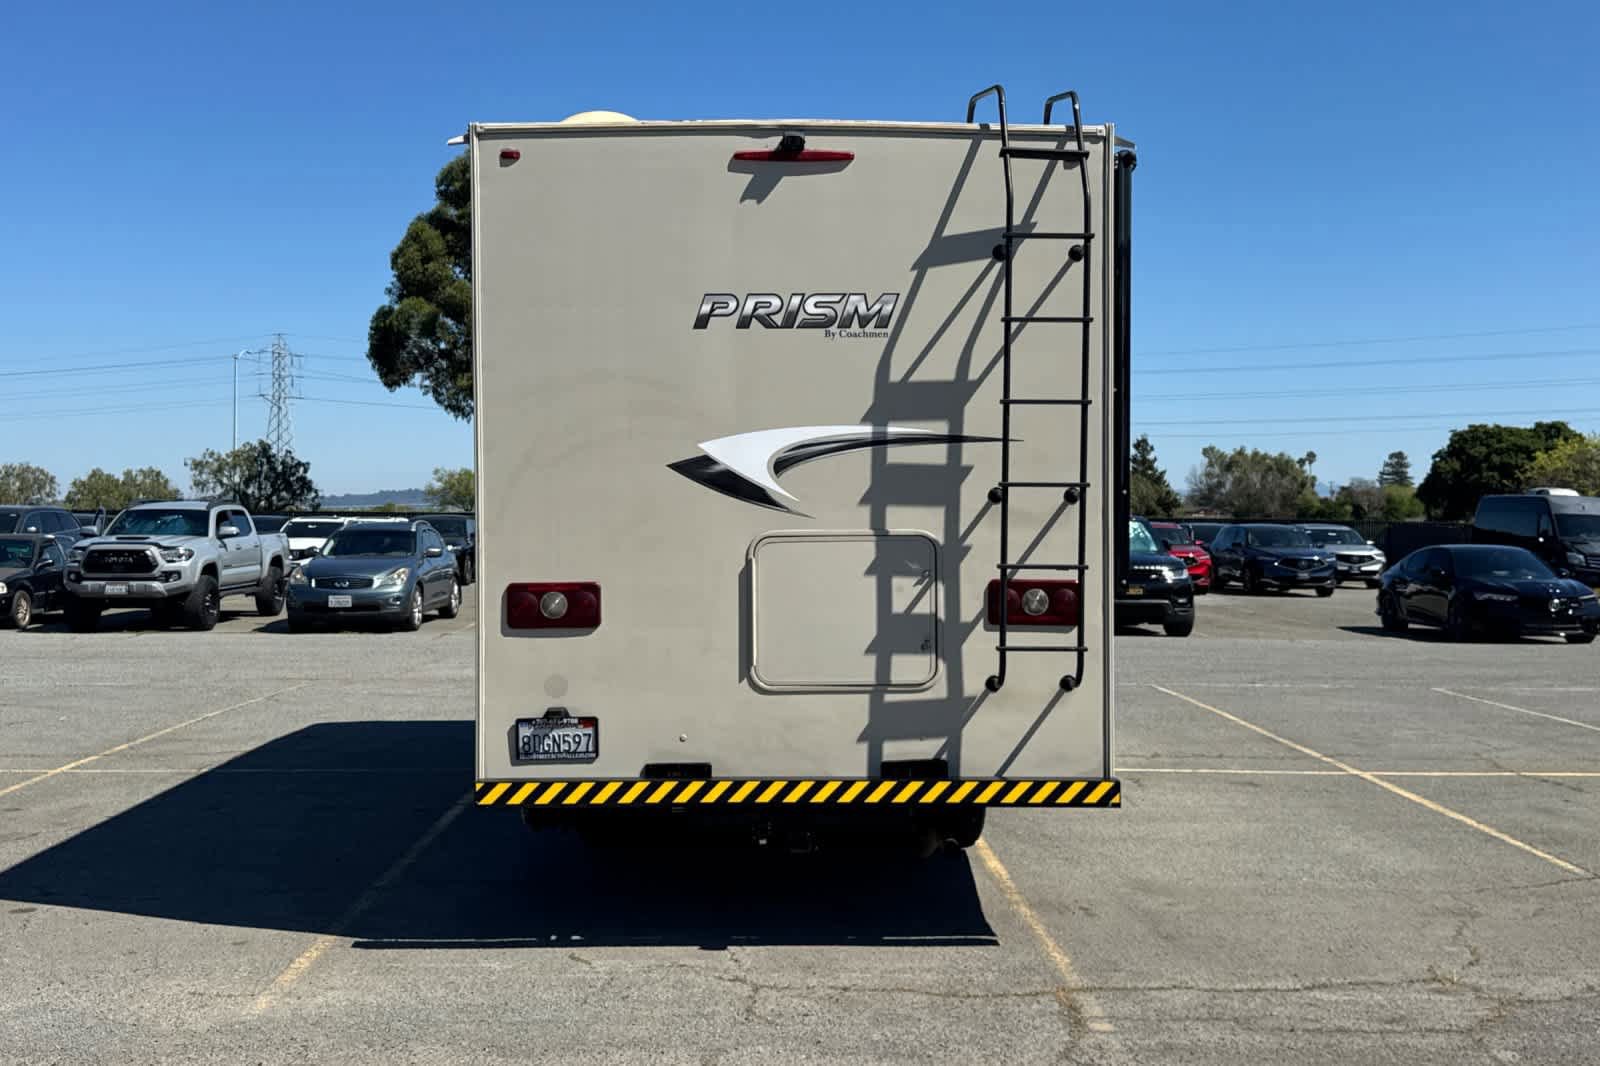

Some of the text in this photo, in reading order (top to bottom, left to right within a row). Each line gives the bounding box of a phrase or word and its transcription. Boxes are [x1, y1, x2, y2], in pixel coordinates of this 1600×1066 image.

[693, 293, 900, 330] PRISM
[824, 330, 889, 339] By Coachmen
